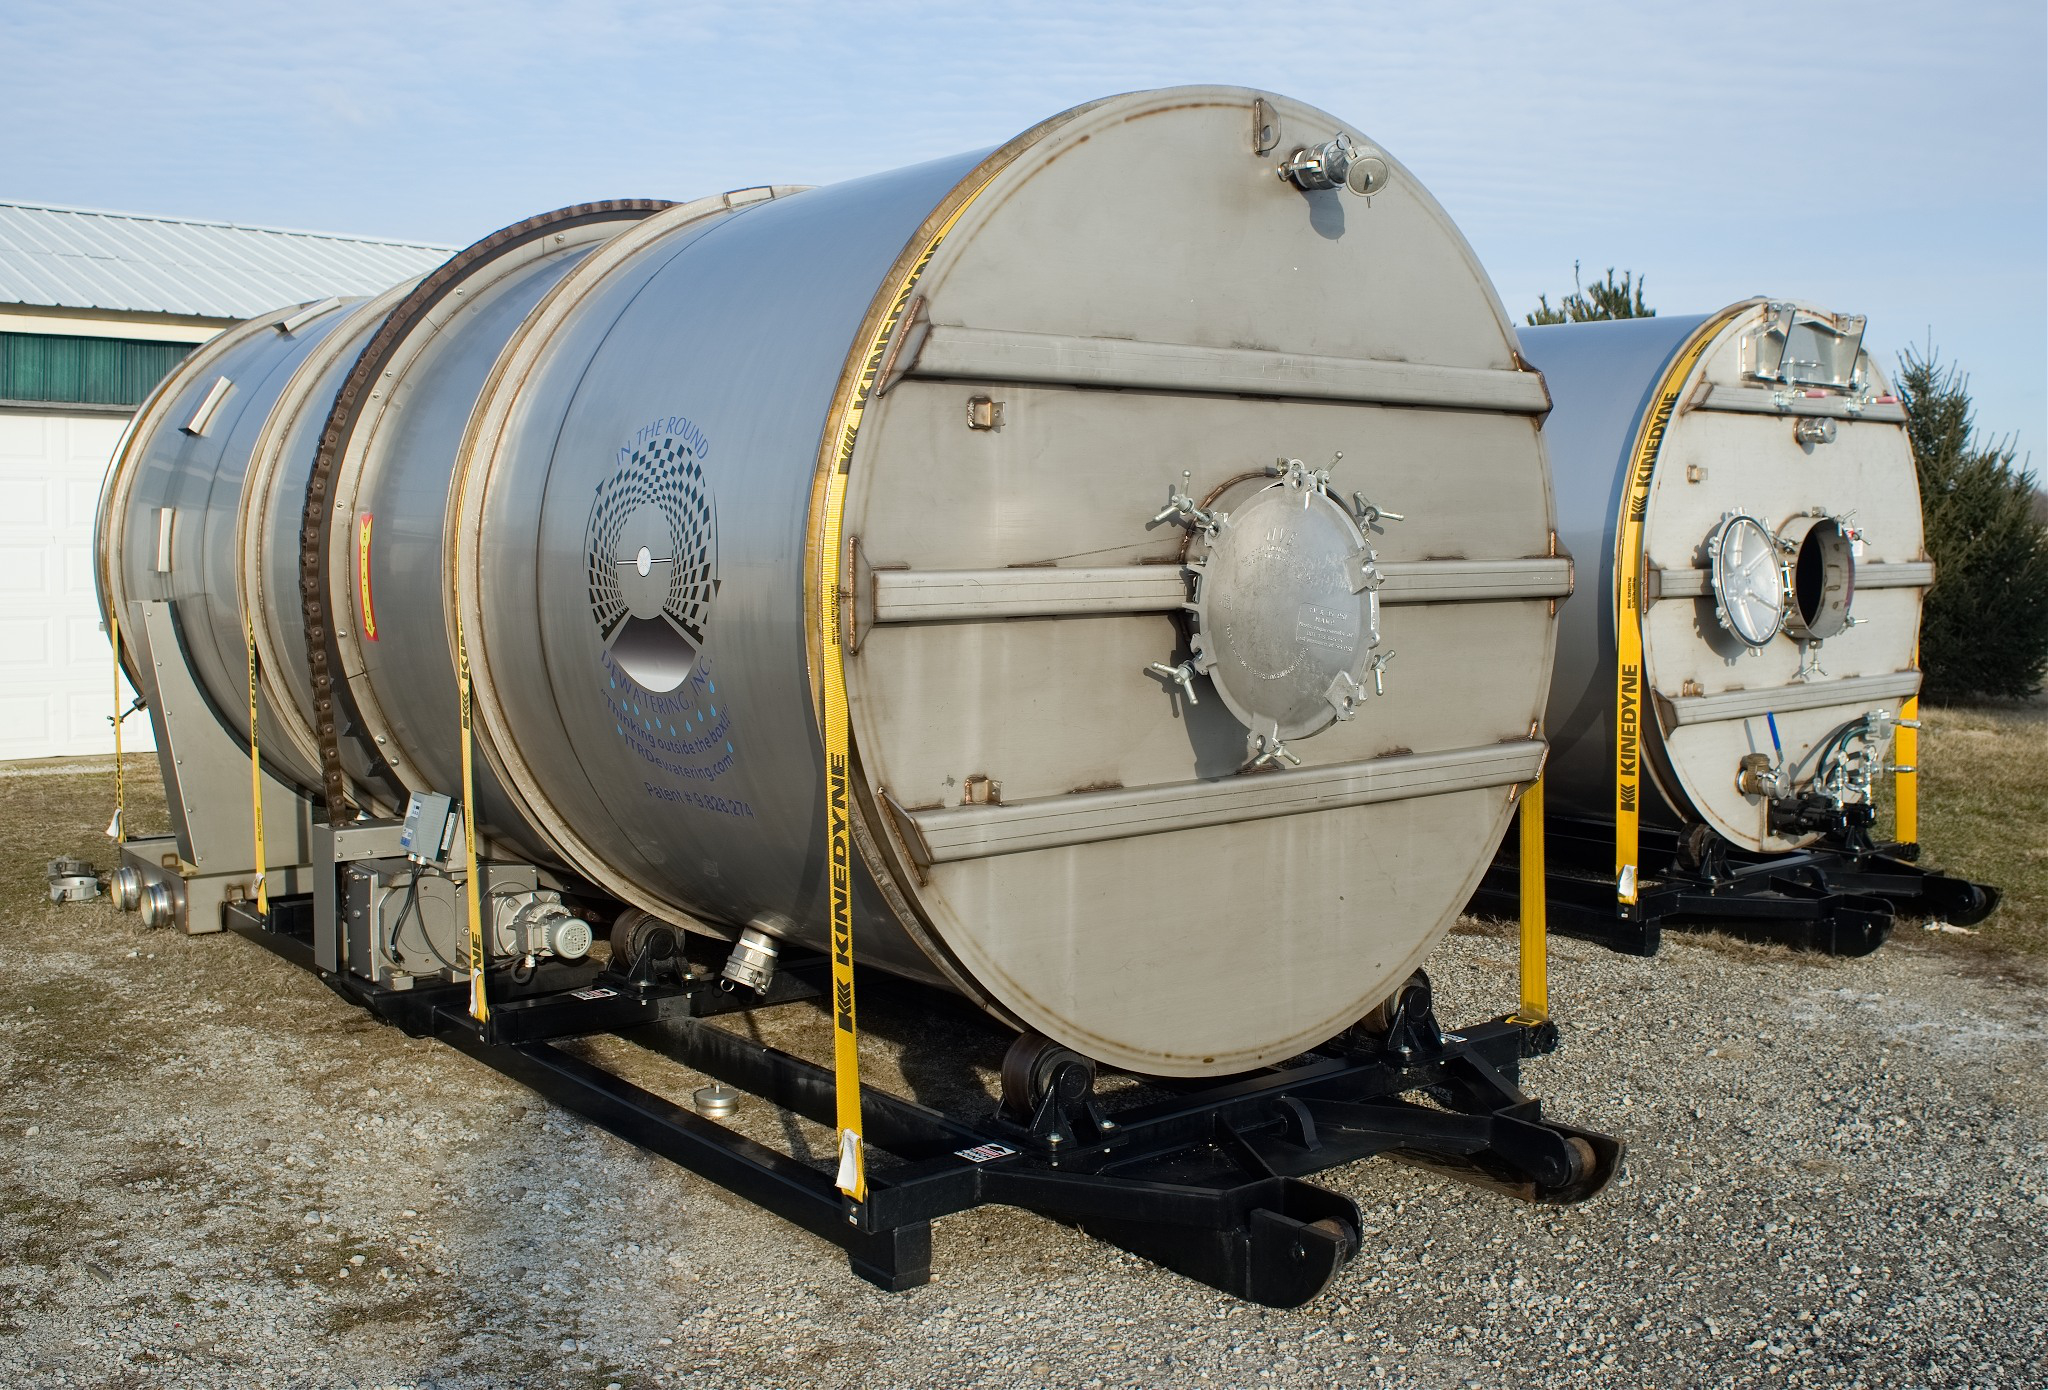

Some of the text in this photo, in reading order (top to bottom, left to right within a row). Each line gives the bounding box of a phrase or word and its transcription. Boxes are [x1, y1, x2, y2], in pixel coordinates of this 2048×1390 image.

[616, 416, 709, 466] IN THE ROUND
[1635, 391, 1681, 488] KINEDYNE
[690, 655, 713, 696] INC.
[657, 738, 696, 755] outside
[695, 736, 712, 753] the
[1620, 664, 1638, 777] KINEDYNE
[624, 732, 734, 782] ITRDewatering.com
[644, 781, 685, 804] Patent
[831, 752, 851, 967] KINEDYNE
